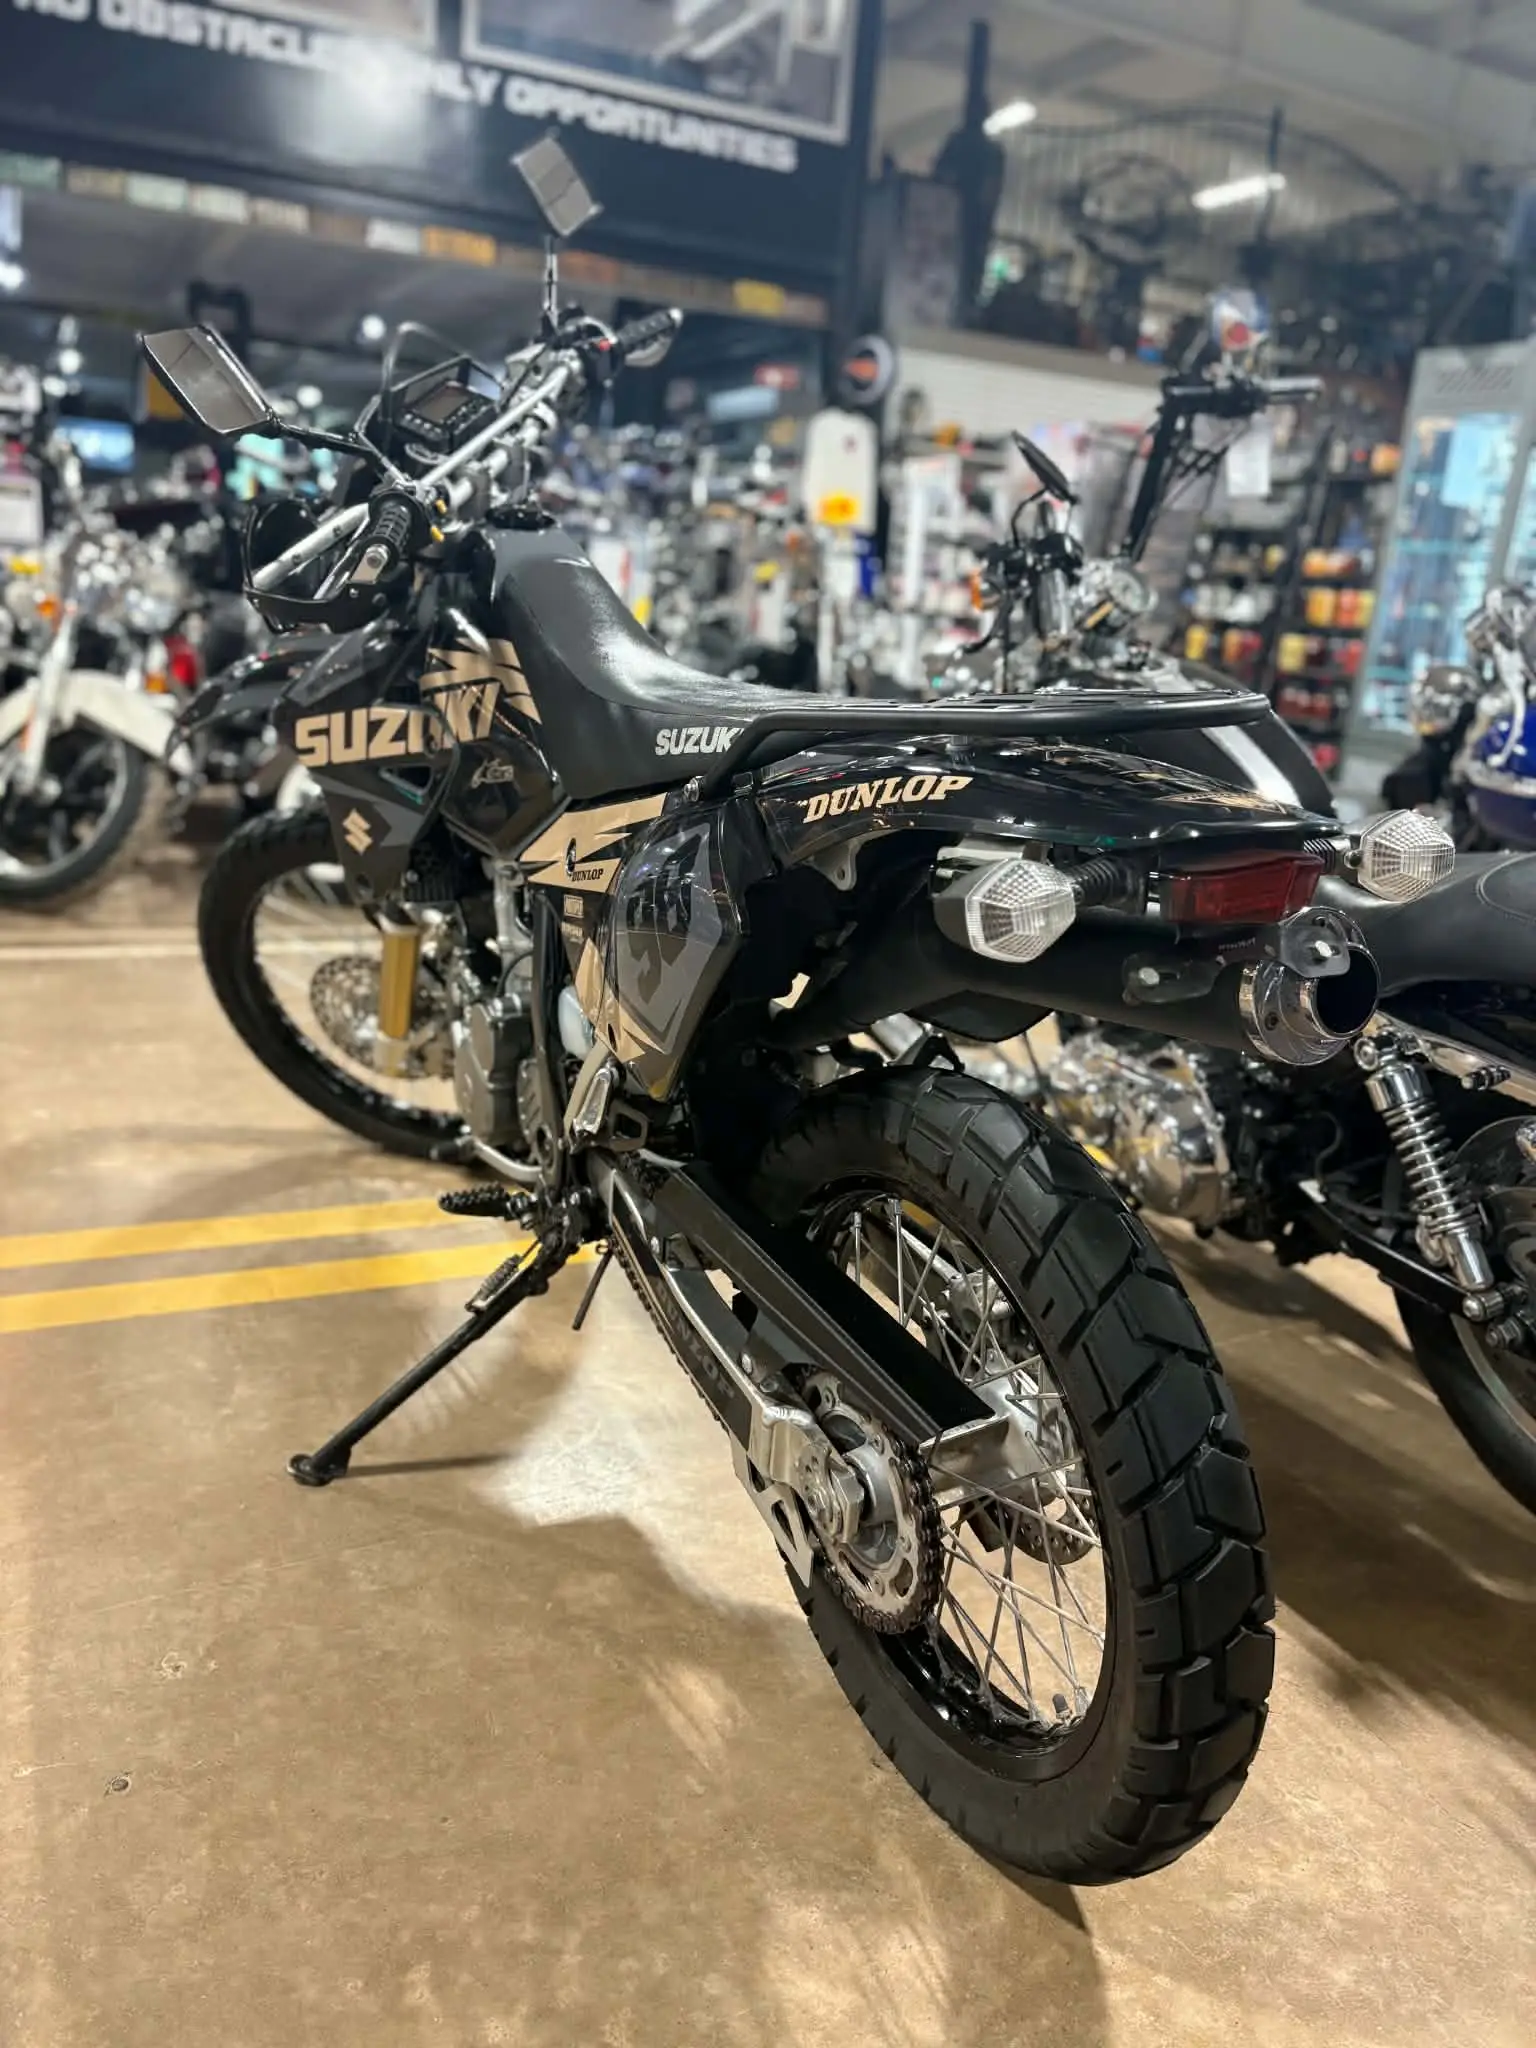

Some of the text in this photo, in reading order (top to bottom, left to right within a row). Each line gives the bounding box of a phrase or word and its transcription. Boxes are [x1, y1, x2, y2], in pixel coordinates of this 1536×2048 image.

[504, 77, 796, 174] OPPORTUNITIES
[295, 681, 500, 766] SUZUKI
[655, 726, 745, 756] SUZUK
[803, 775, 974, 823] DUNLOP
[571, 868, 604, 882] DUNLOP
[652, 1278, 735, 1399] DUNLOP
